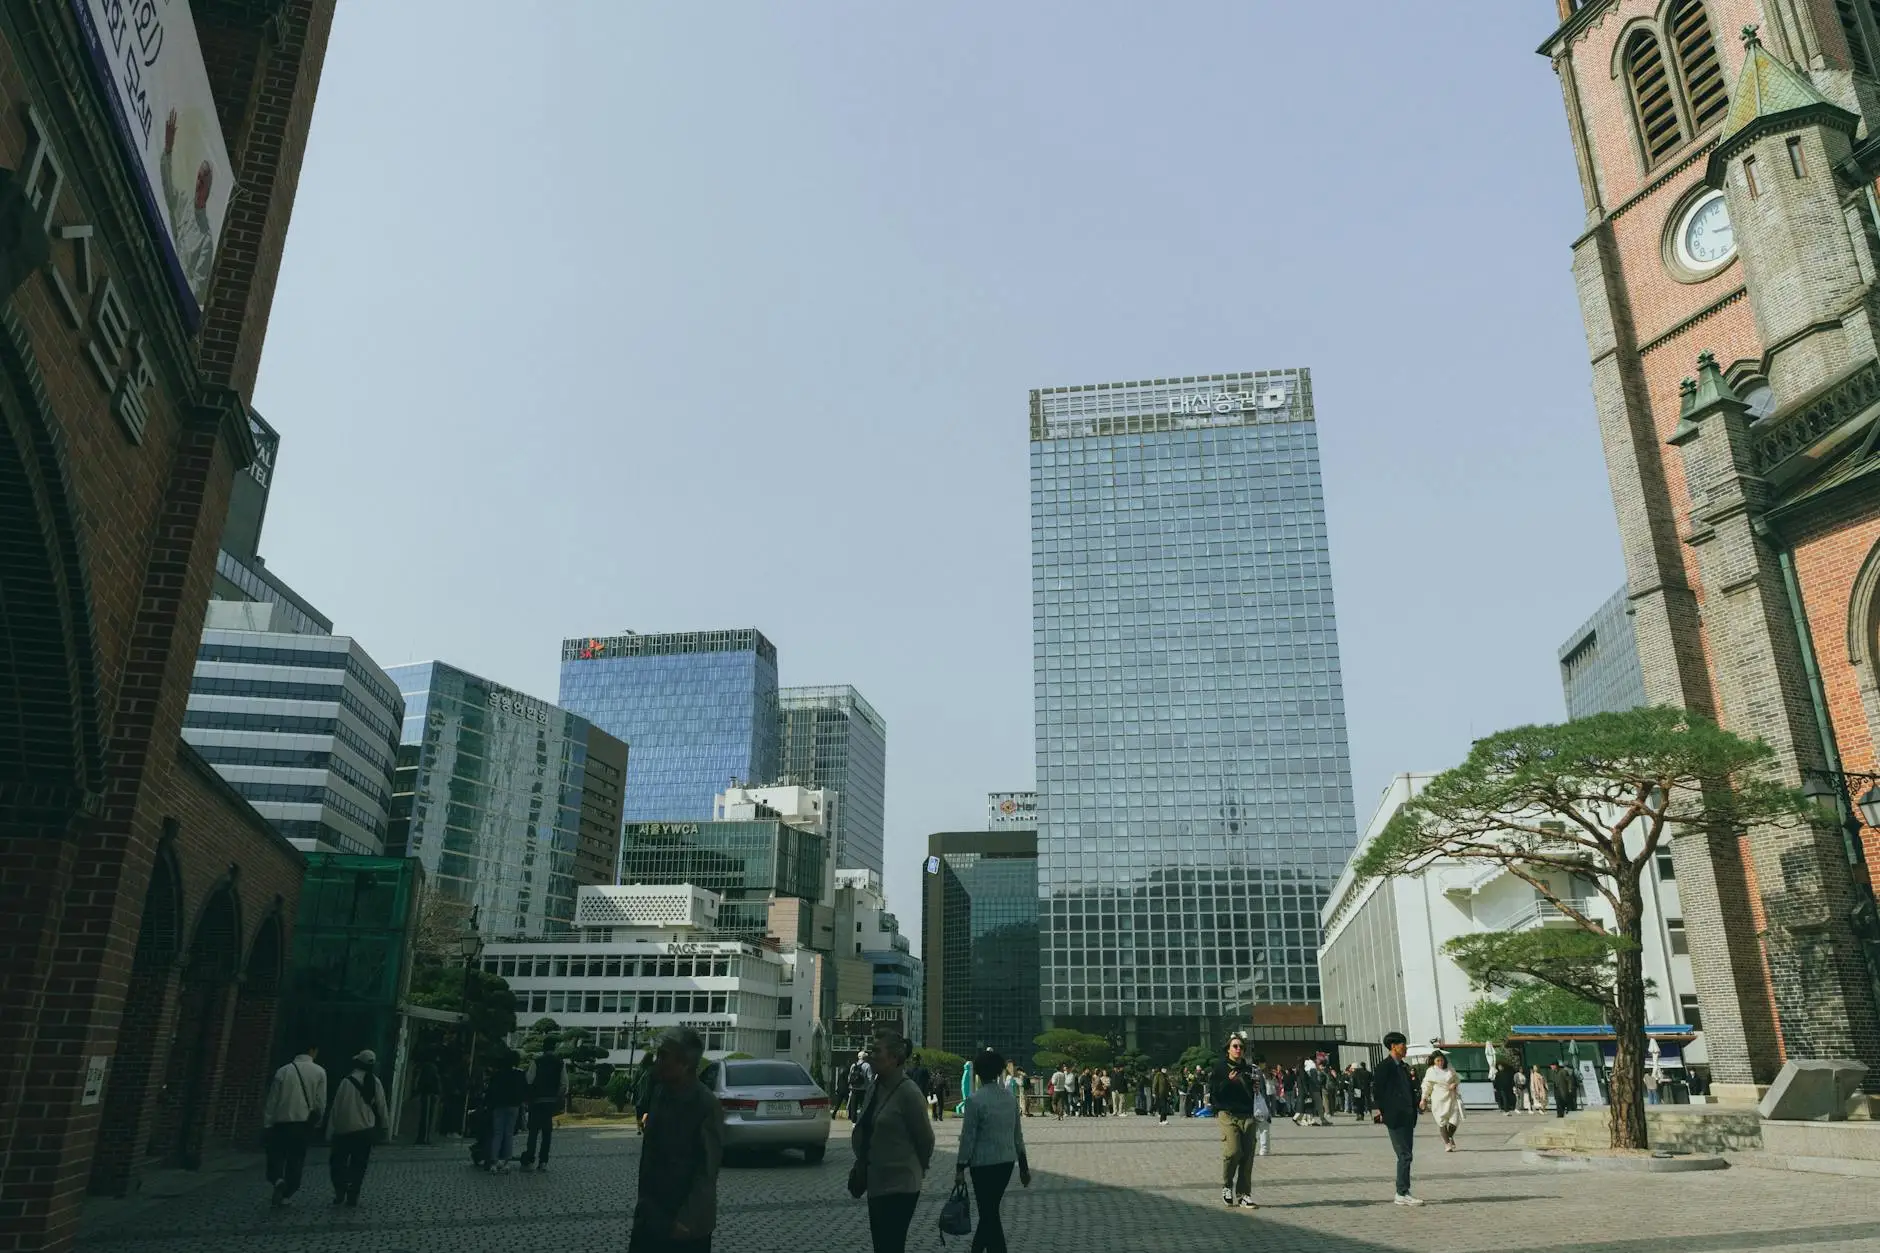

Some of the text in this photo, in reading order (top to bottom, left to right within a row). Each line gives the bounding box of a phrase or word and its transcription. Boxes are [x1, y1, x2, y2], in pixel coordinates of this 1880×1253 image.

[129, 0, 164, 67] 회)
[1711, 205, 1720, 216] 12
[1693, 227, 1704, 239] 10
[1694, 240, 1700, 250] 9
[1700, 247, 1706, 257] 8
[1709, 248, 1715, 259] 7
[1168, 389, 1256, 415] 대신증권
[244, 461, 267, 488] TEL
